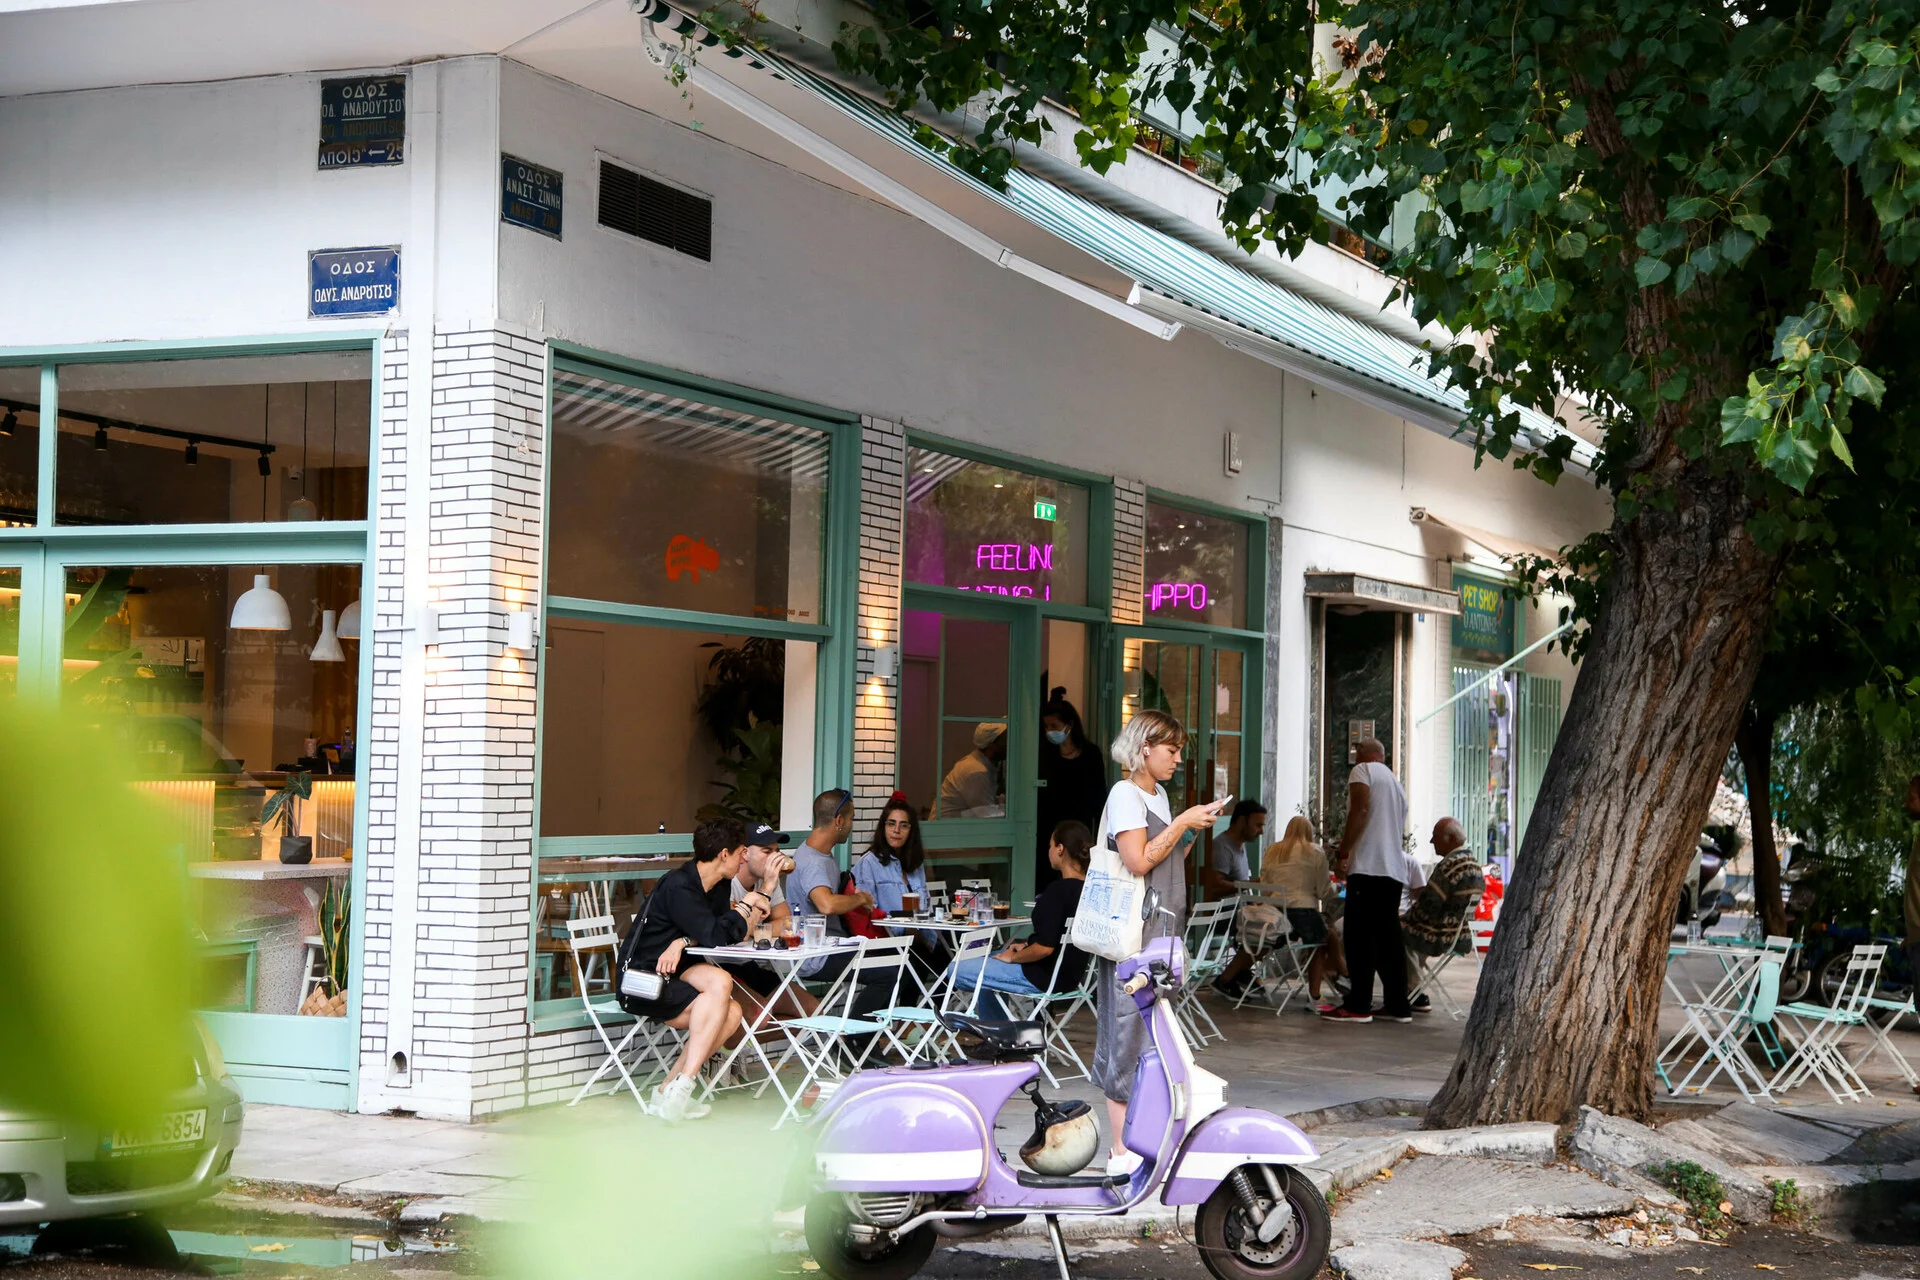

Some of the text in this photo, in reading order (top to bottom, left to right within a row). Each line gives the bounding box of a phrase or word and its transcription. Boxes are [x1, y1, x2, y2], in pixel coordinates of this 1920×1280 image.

[342, 83, 388, 99] ΟΔΟΣ
[517, 166, 550, 188] ΟΔΟΣ
[330, 260, 376, 275] ΟΔΟΣ
[314, 287, 340, 303] ΟΔΥΣ.
[1463, 584, 1499, 612] PET SHOP
